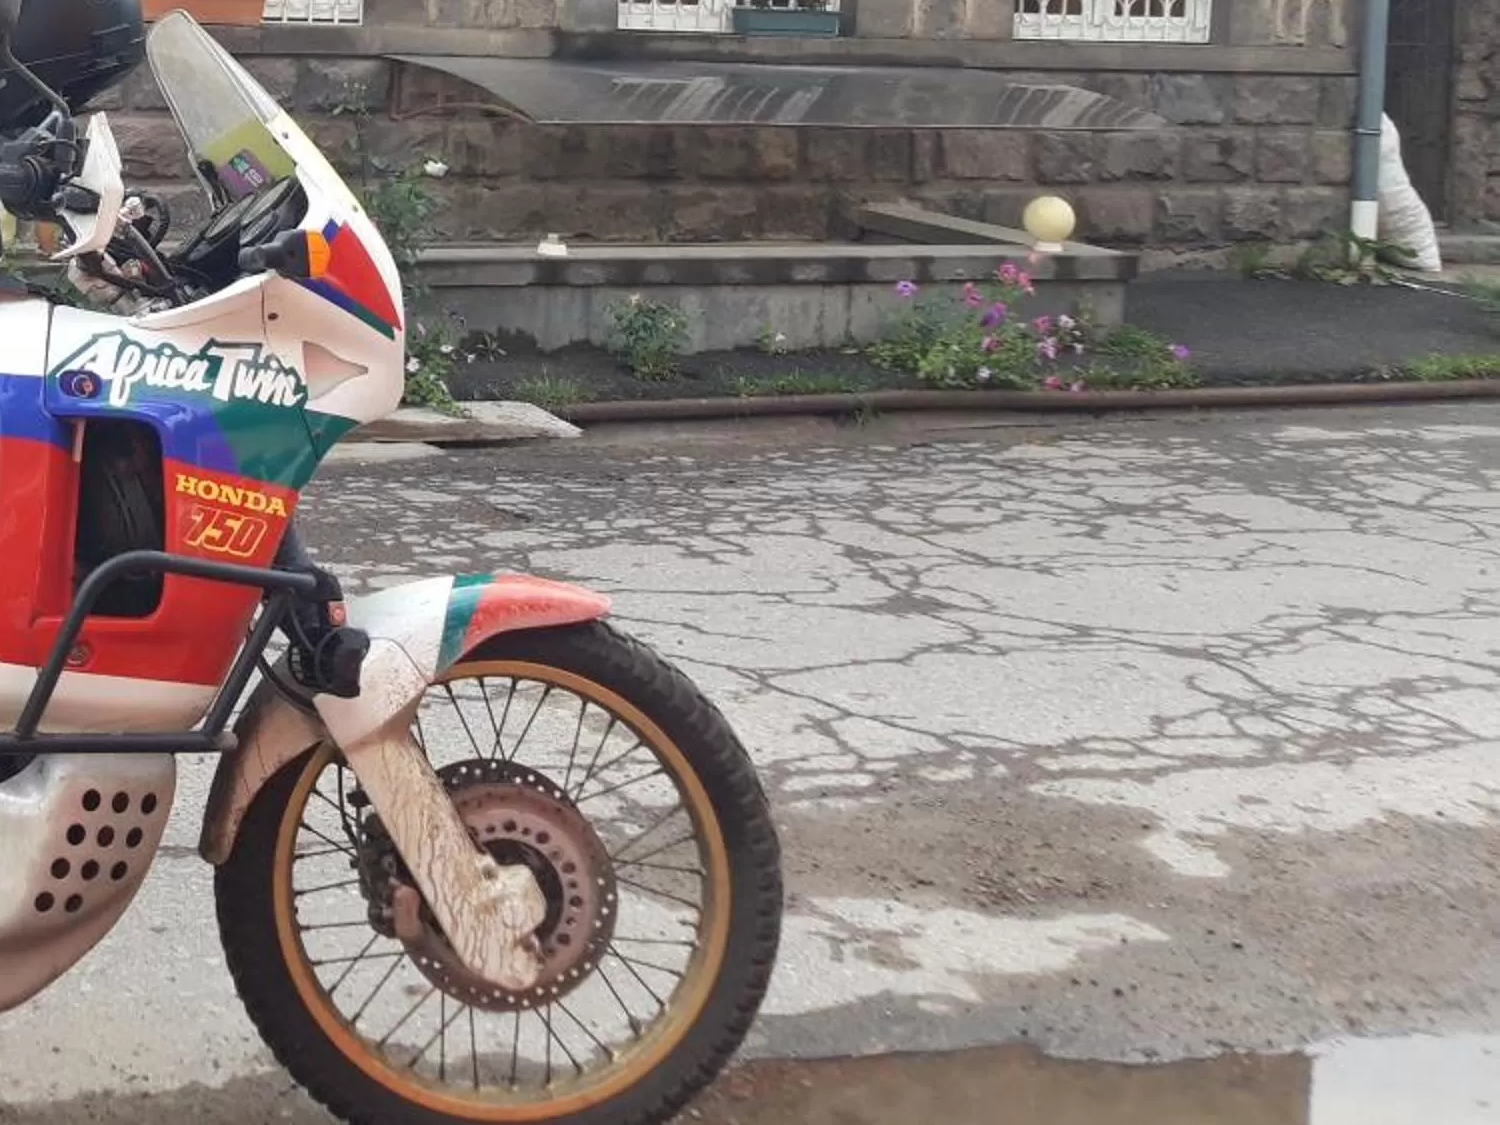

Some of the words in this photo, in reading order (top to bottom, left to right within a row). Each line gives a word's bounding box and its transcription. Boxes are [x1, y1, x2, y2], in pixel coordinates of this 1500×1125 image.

[54, 331, 212, 407] Africa
[205, 339, 307, 409] Twin
[175, 474, 288, 517] HONDA
[183, 506, 270, 558] 750
